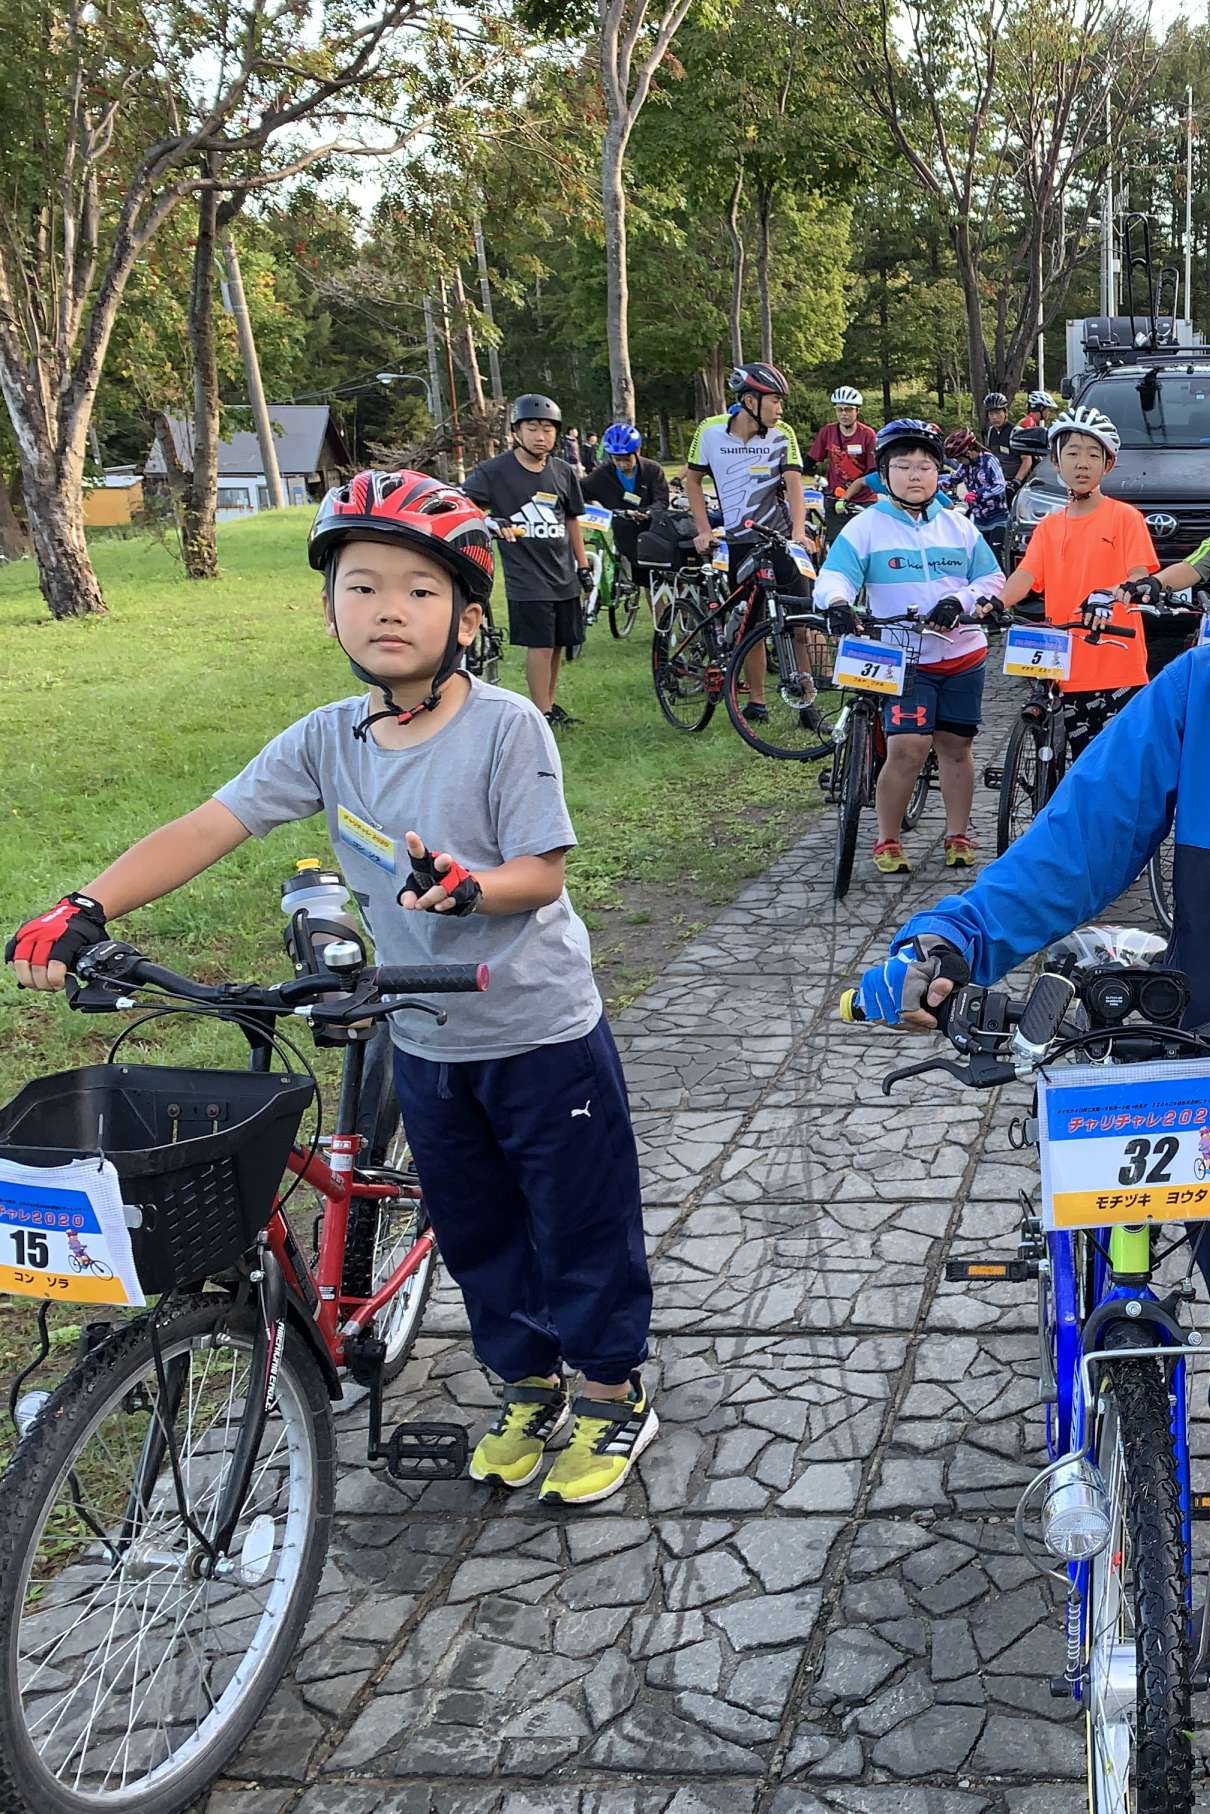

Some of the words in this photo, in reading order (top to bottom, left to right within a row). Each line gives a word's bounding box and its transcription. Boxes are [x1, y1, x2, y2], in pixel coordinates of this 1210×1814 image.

[720, 447, 770, 455] SHIMANO
[511, 521, 566, 538] didas
[1032, 651, 1043, 665] 5
[861, 663, 880, 678] 31
[1118, 1137, 1180, 1186] 32
[1166, 1189, 1209, 1205] ヨウタ
[10, 1229, 49, 1269] 15
[14, 1271, 35, 1284] コン
[46, 1276, 70, 1289] ソラ
